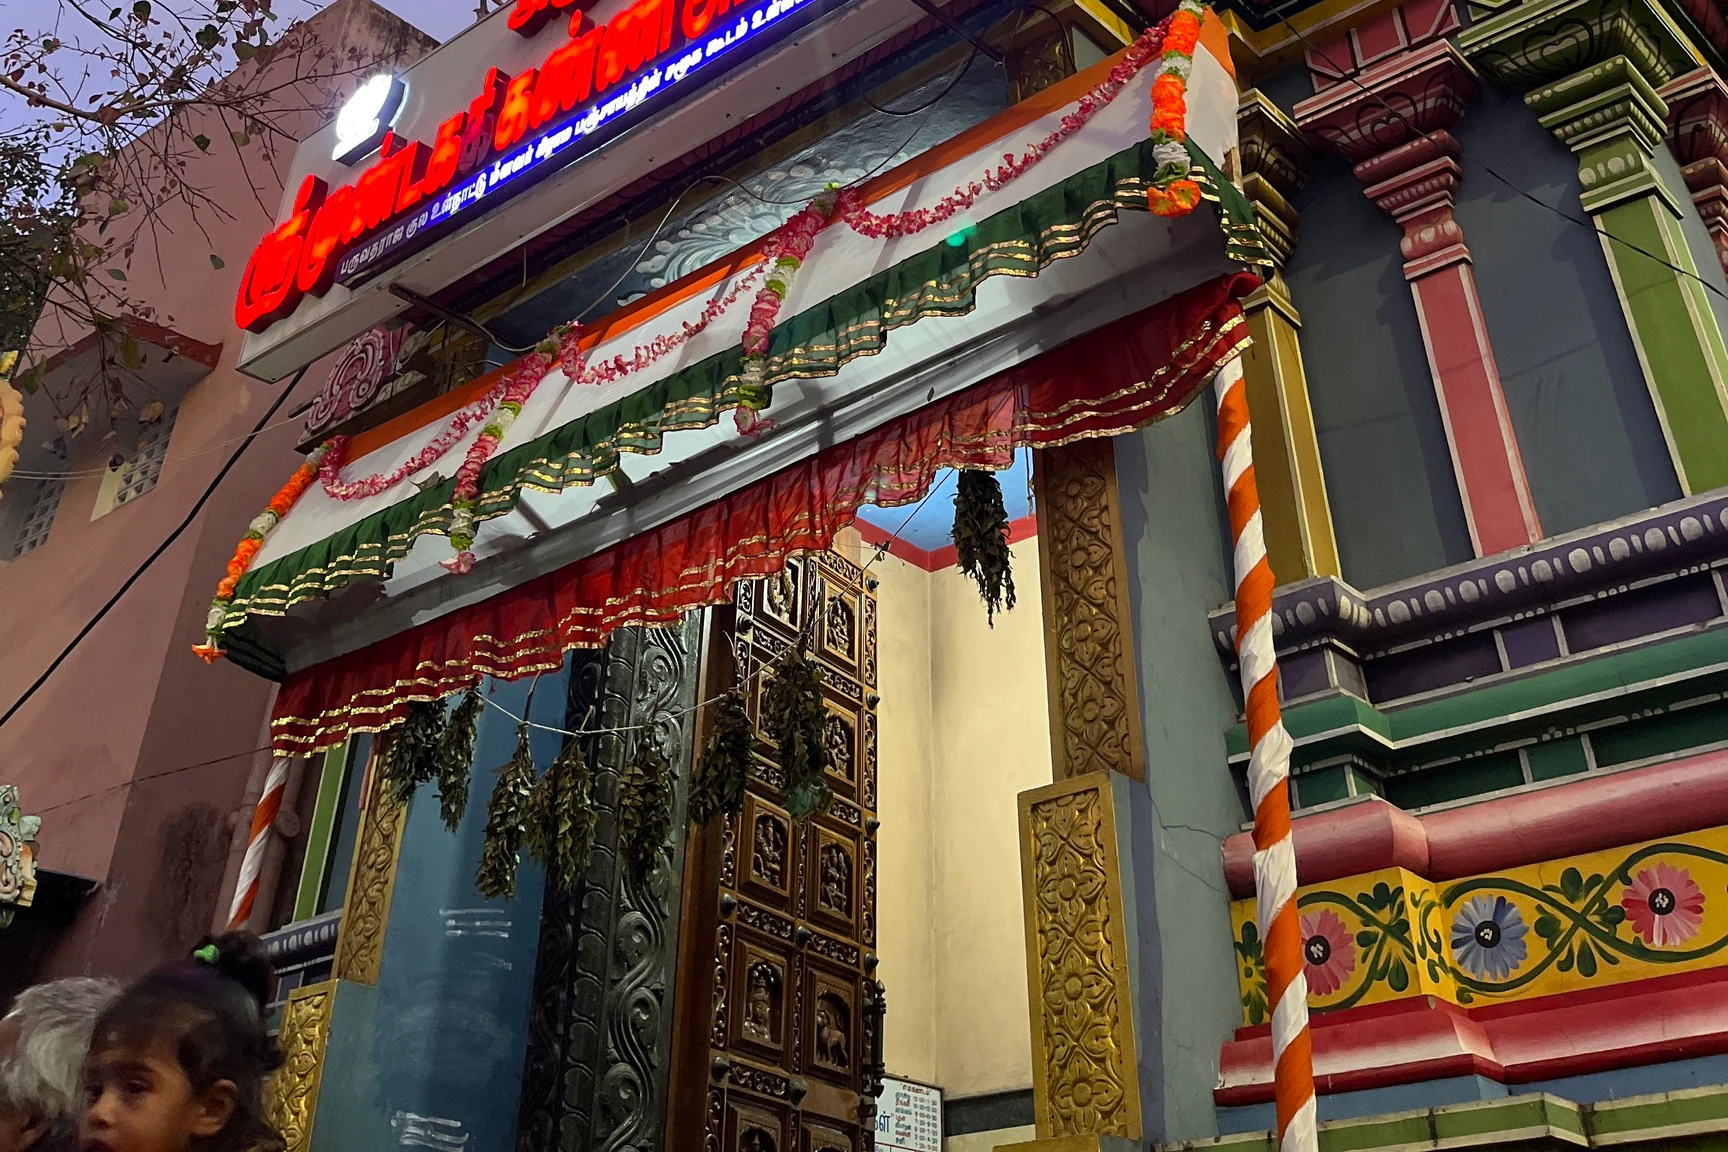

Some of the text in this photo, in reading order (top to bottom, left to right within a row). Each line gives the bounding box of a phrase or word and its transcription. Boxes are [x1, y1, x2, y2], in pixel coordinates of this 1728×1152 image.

[340, 228, 403, 273] பருவதராஜ
[405, 210, 429, 239] குல
[430, 172, 486, 220] உள்நாட்டு
[489, 145, 535, 186] மீனவர்
